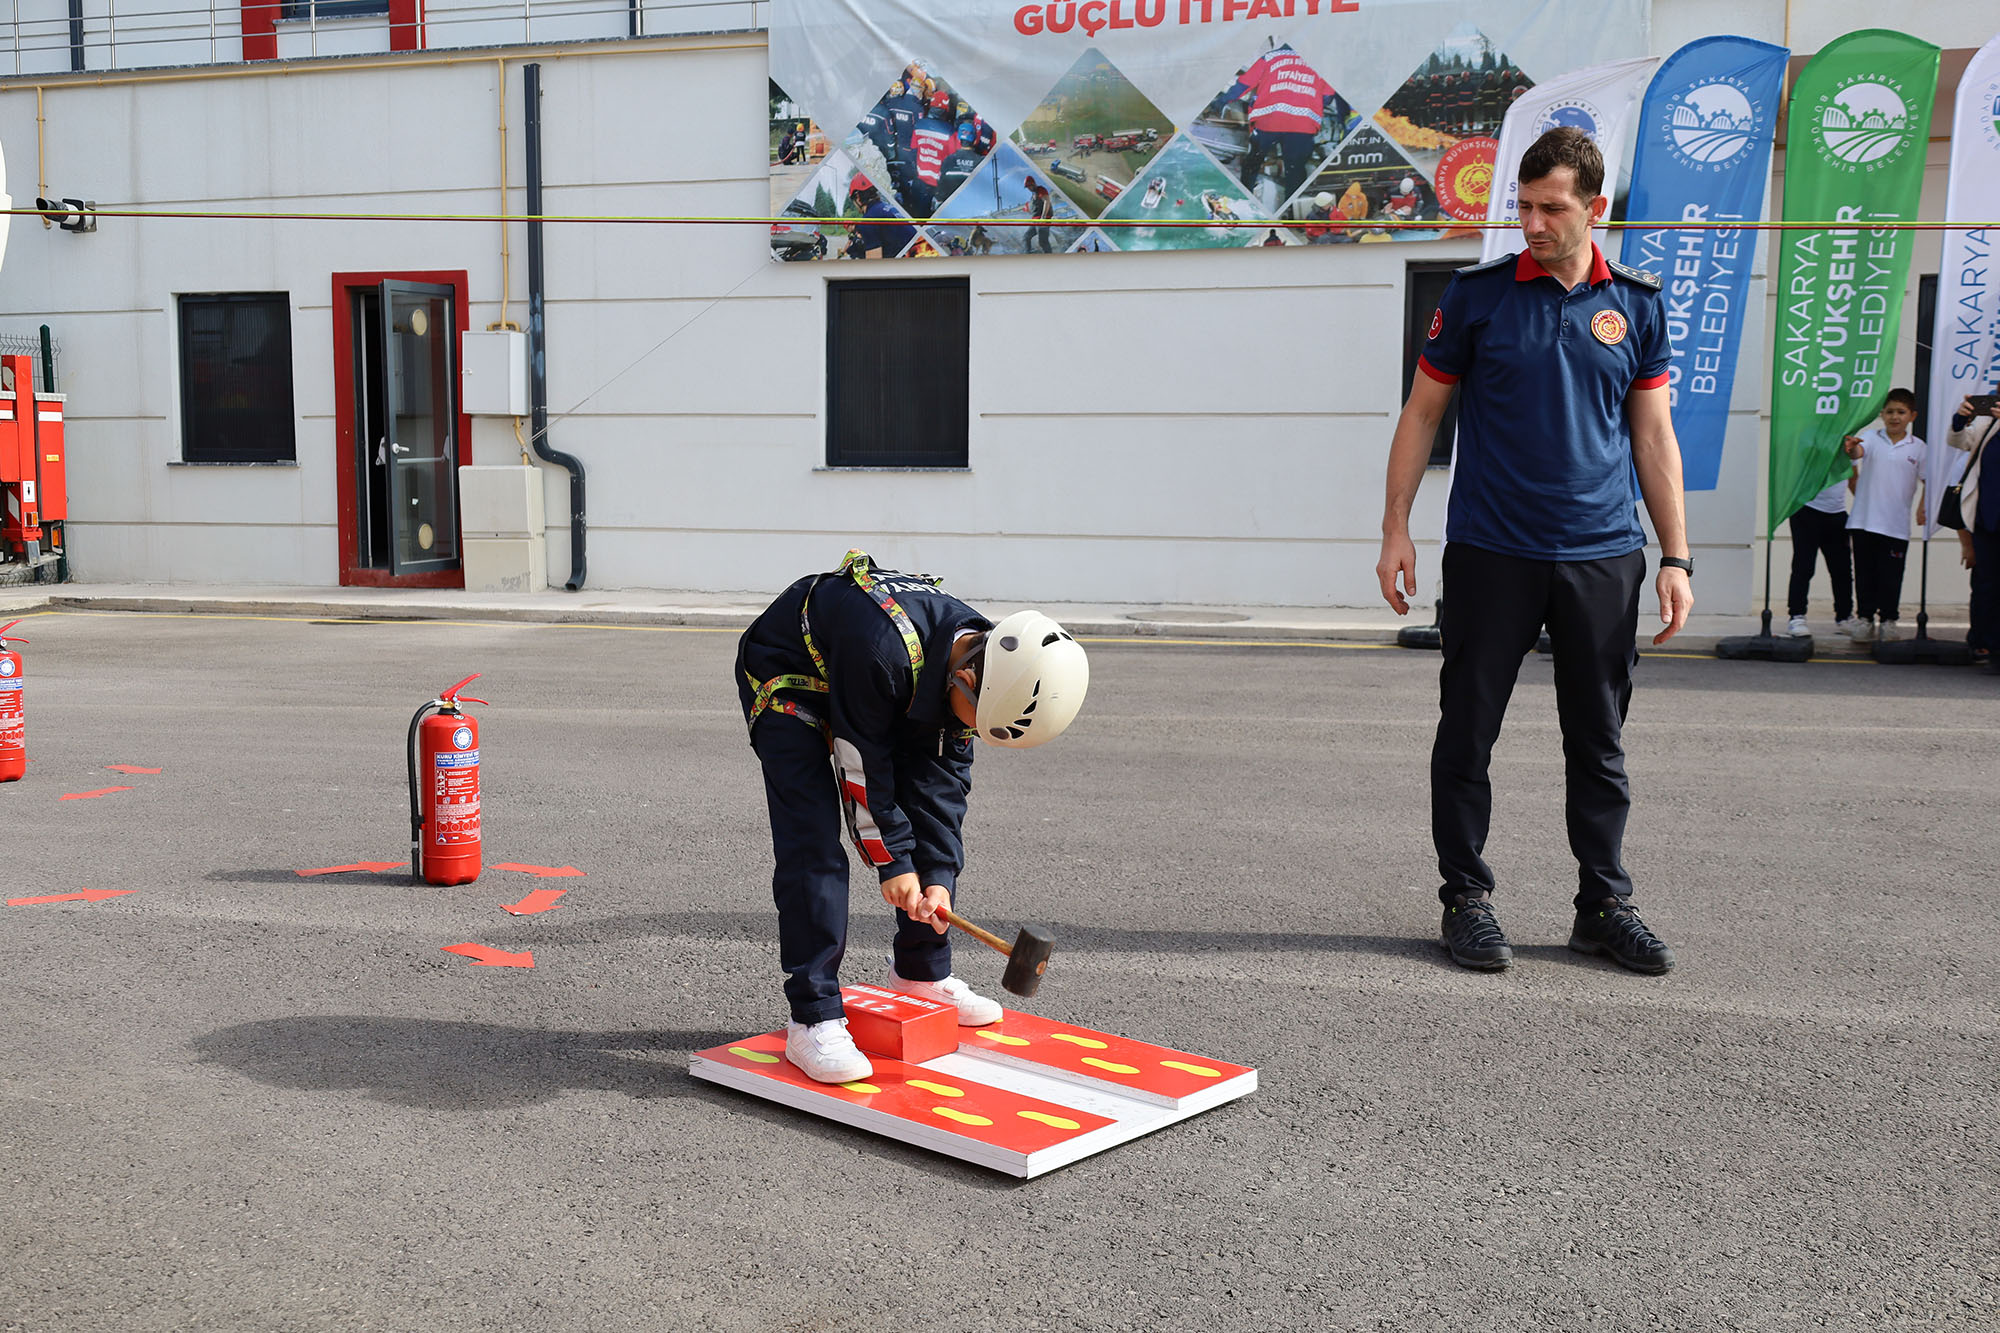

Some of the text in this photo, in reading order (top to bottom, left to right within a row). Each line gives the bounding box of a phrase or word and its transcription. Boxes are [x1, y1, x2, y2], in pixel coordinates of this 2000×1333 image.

[1347, 152, 1383, 165] mm
[1689, 76, 1750, 94] SAKARYA
[1836, 73, 1903, 92] SAKARYA
[1438, 140, 1498, 206] SAKARYA BÜYÜKŞEHİ
[1690, 213, 1744, 395] BELEDİYESİ
[1782, 233, 1822, 387] SAKARYA
[1811, 205, 1863, 415] BÜYÜKŞEHİR
[1849, 213, 1900, 398] BELEDİYESİ
[1951, 223, 1991, 380] SAKARYA
